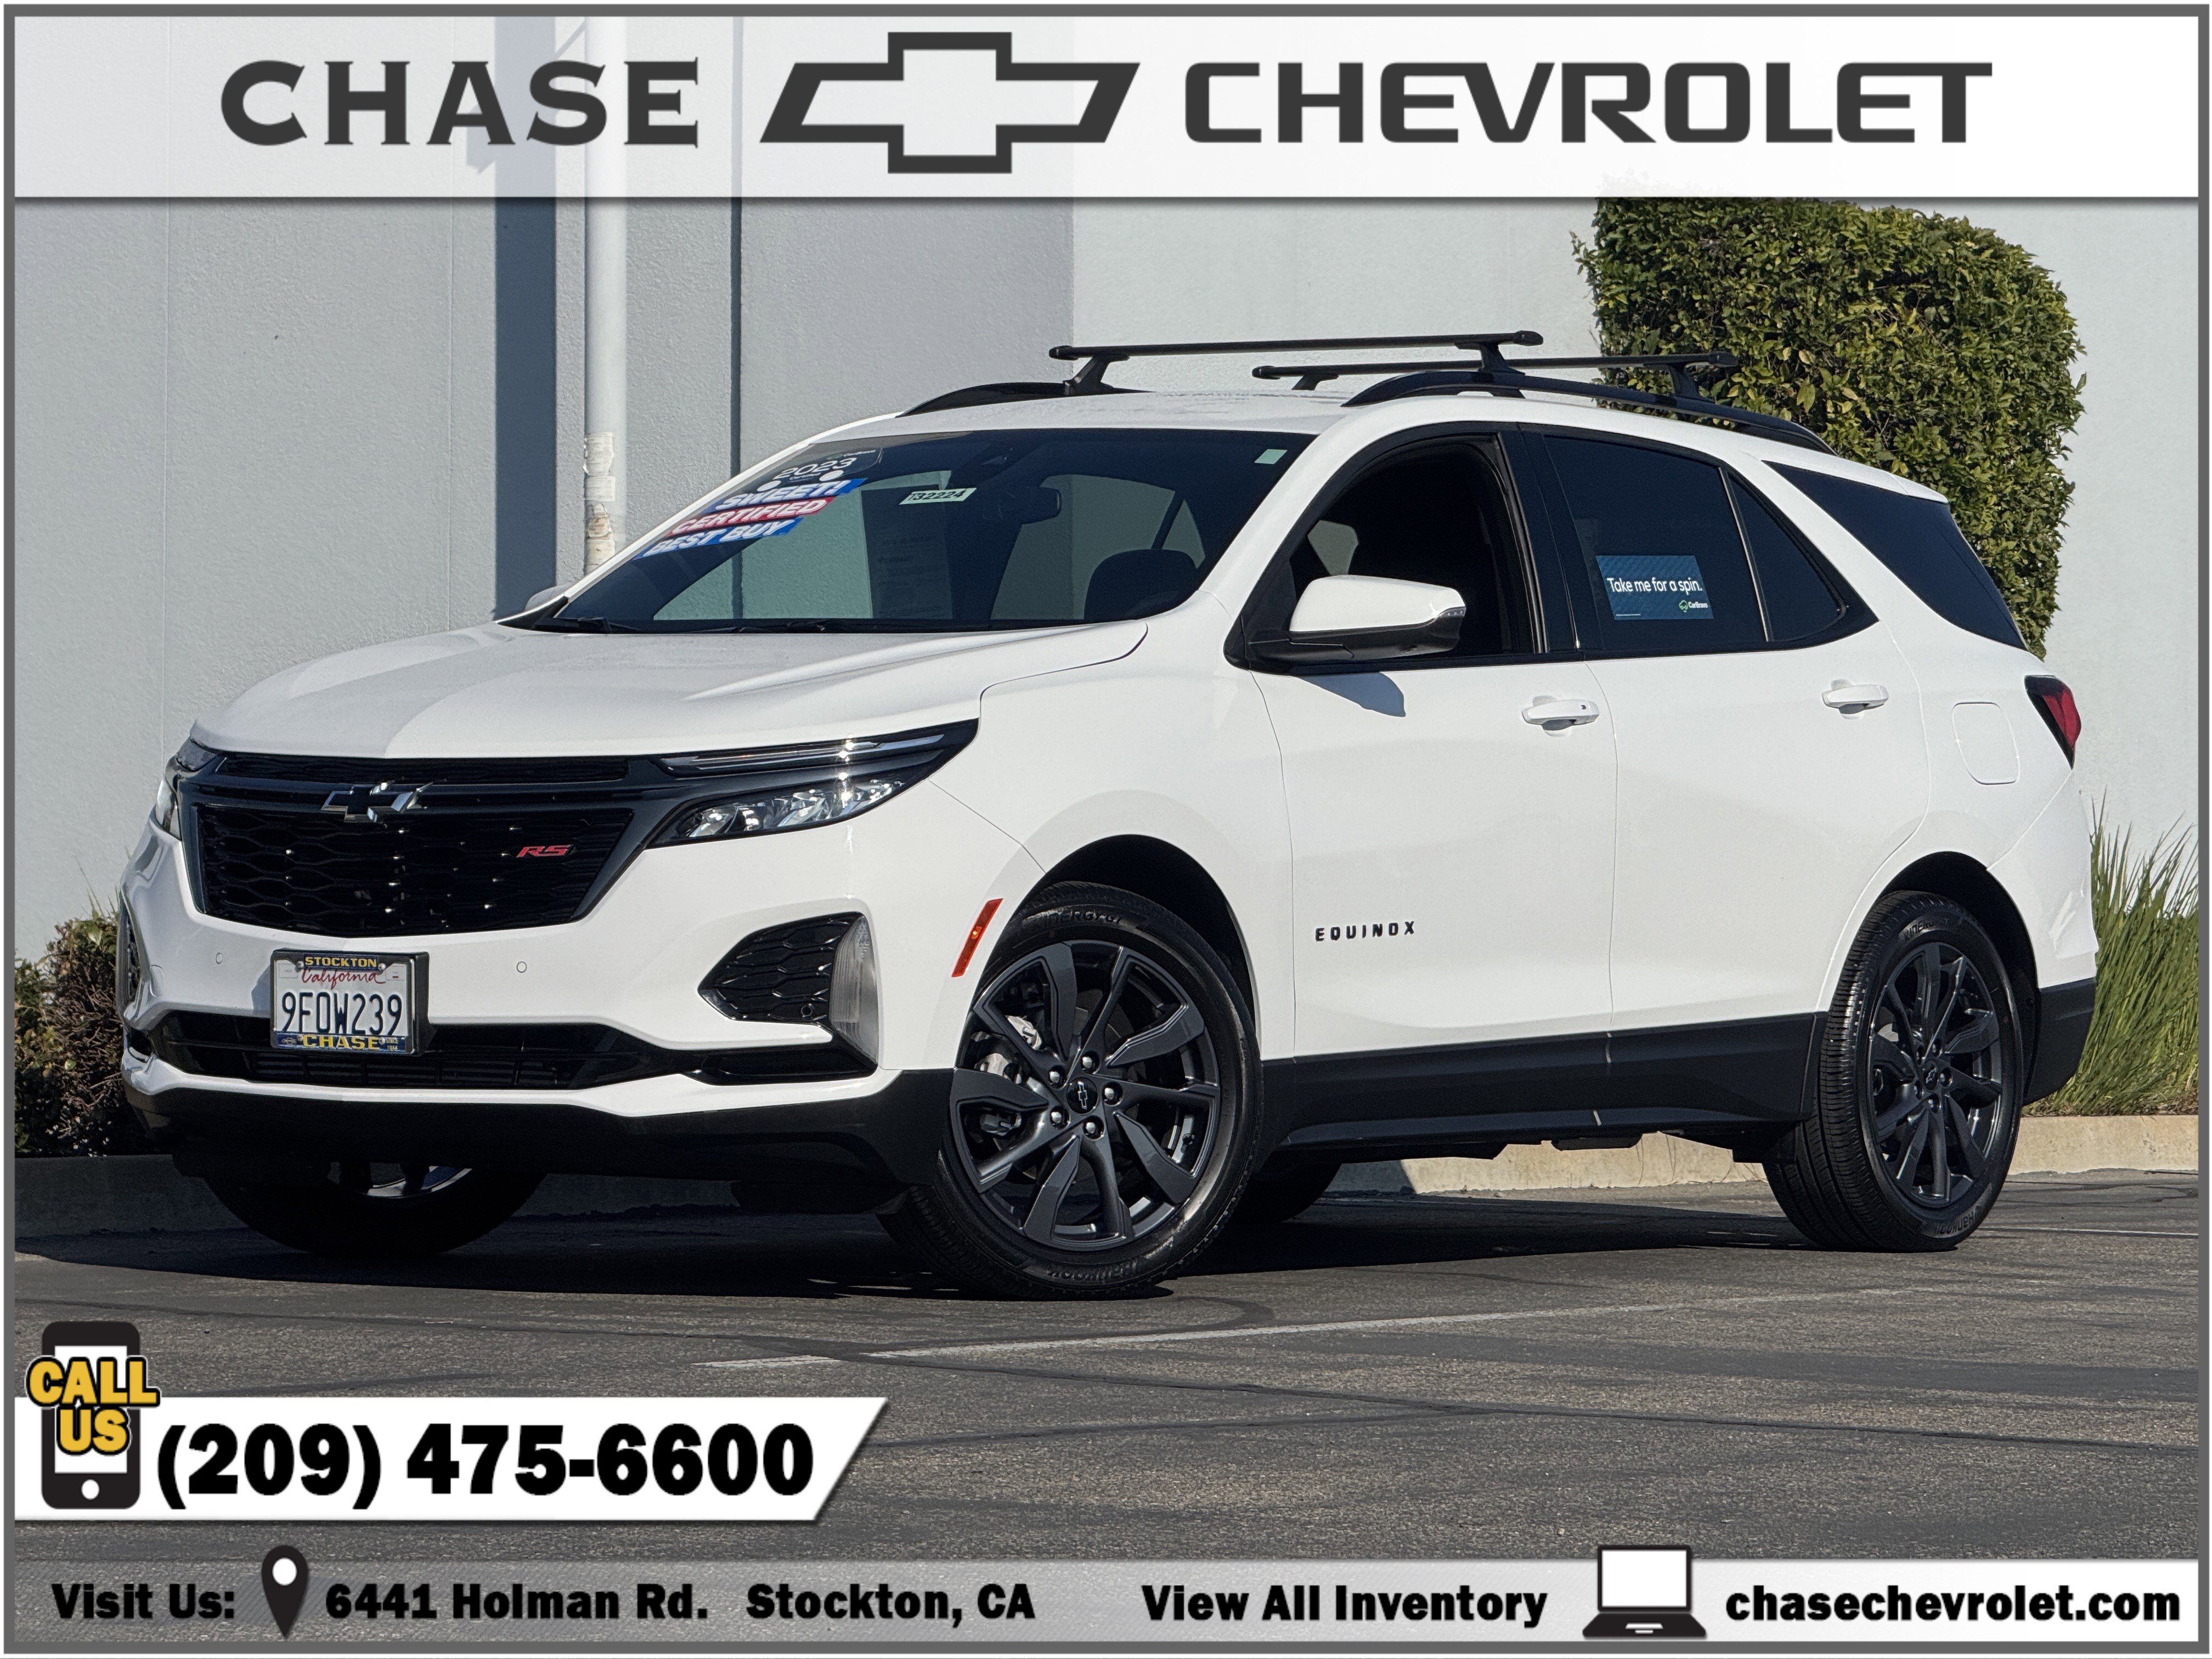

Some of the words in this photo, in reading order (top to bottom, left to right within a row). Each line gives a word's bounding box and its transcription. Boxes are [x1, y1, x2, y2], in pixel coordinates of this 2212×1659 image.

[772, 458, 856, 479] 2023
[715, 479, 851, 510] SWEET!
[672, 499, 827, 534] CERTIFIED
[642, 529, 727, 557] BEST
[719, 520, 795, 543] BUY
[1606, 578, 1633, 592] Take
[1634, 580, 1651, 592] me
[1652, 577, 1667, 592] for
[1669, 580, 1677, 592] a
[1678, 577, 1702, 595] spin.
[516, 845, 571, 857] RS
[1315, 921, 1414, 942] EQUINOX
[305, 956, 377, 968] STOCKTON
[302, 969, 386, 990] California
[282, 991, 402, 1036] 9FOW239
[303, 1034, 380, 1051] CHASE
